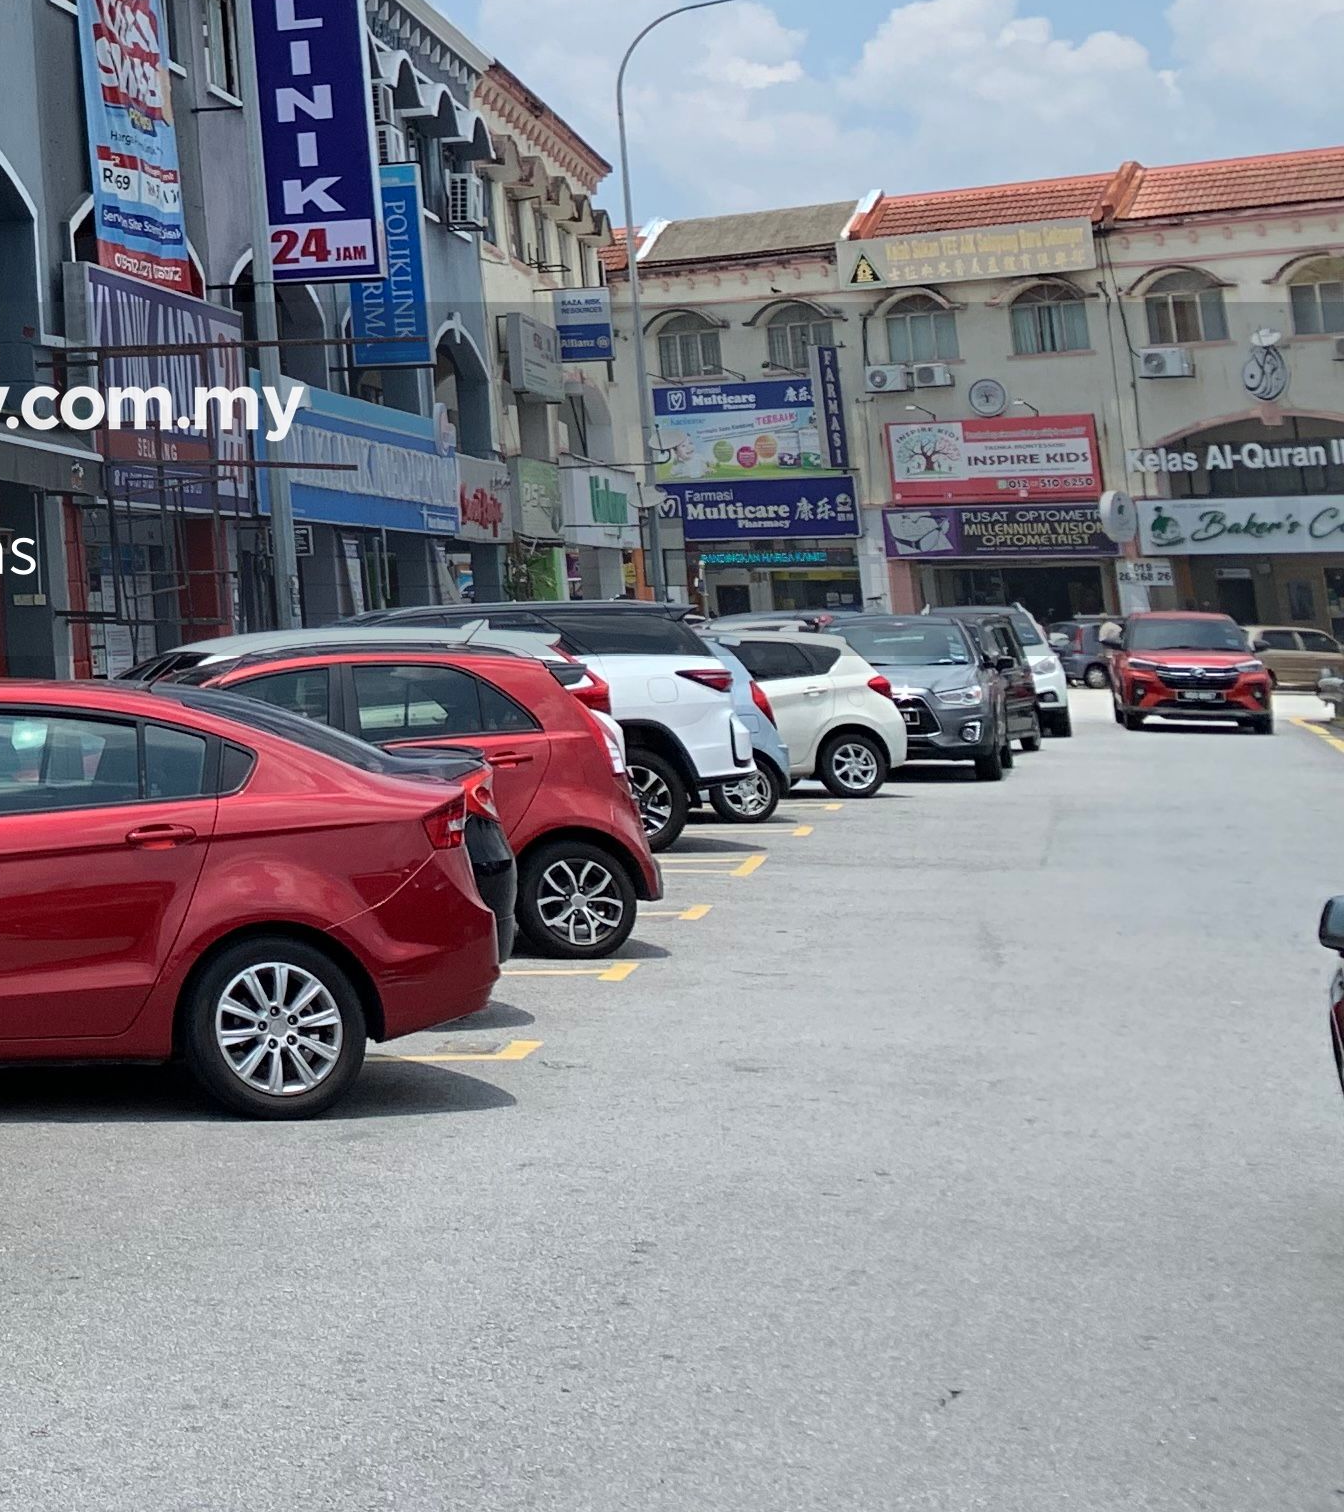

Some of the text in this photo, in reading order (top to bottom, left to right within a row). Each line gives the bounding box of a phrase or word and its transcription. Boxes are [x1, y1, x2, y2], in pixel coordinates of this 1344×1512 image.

[271, 228, 366, 265] 24 JAM
[384, 200, 417, 338] POLIKLINIK
[560, 338, 596, 348] Allianz
[692, 393, 757, 406] Multicare
[823, 351, 844, 464] FARMASI
[755, 412, 796, 426] TERBAIK
[968, 452, 1089, 466] INSPIRE KIDS
[1126, 448, 1199, 473] Kelas
[1206, 443, 1327, 470] Al-Quran
[1008, 480, 1029, 489] 012
[685, 489, 734, 502] Farmasi
[686, 502, 790, 520] Multicare
[962, 510, 1101, 523] PUSAT OPTOMETR
[737, 519, 791, 529] Pharmacy
[964, 522, 1105, 535] MILLENNIUM VISION
[1191, 510, 1302, 542] Baker's
[982, 535, 1090, 546] OPTOMETRIST
